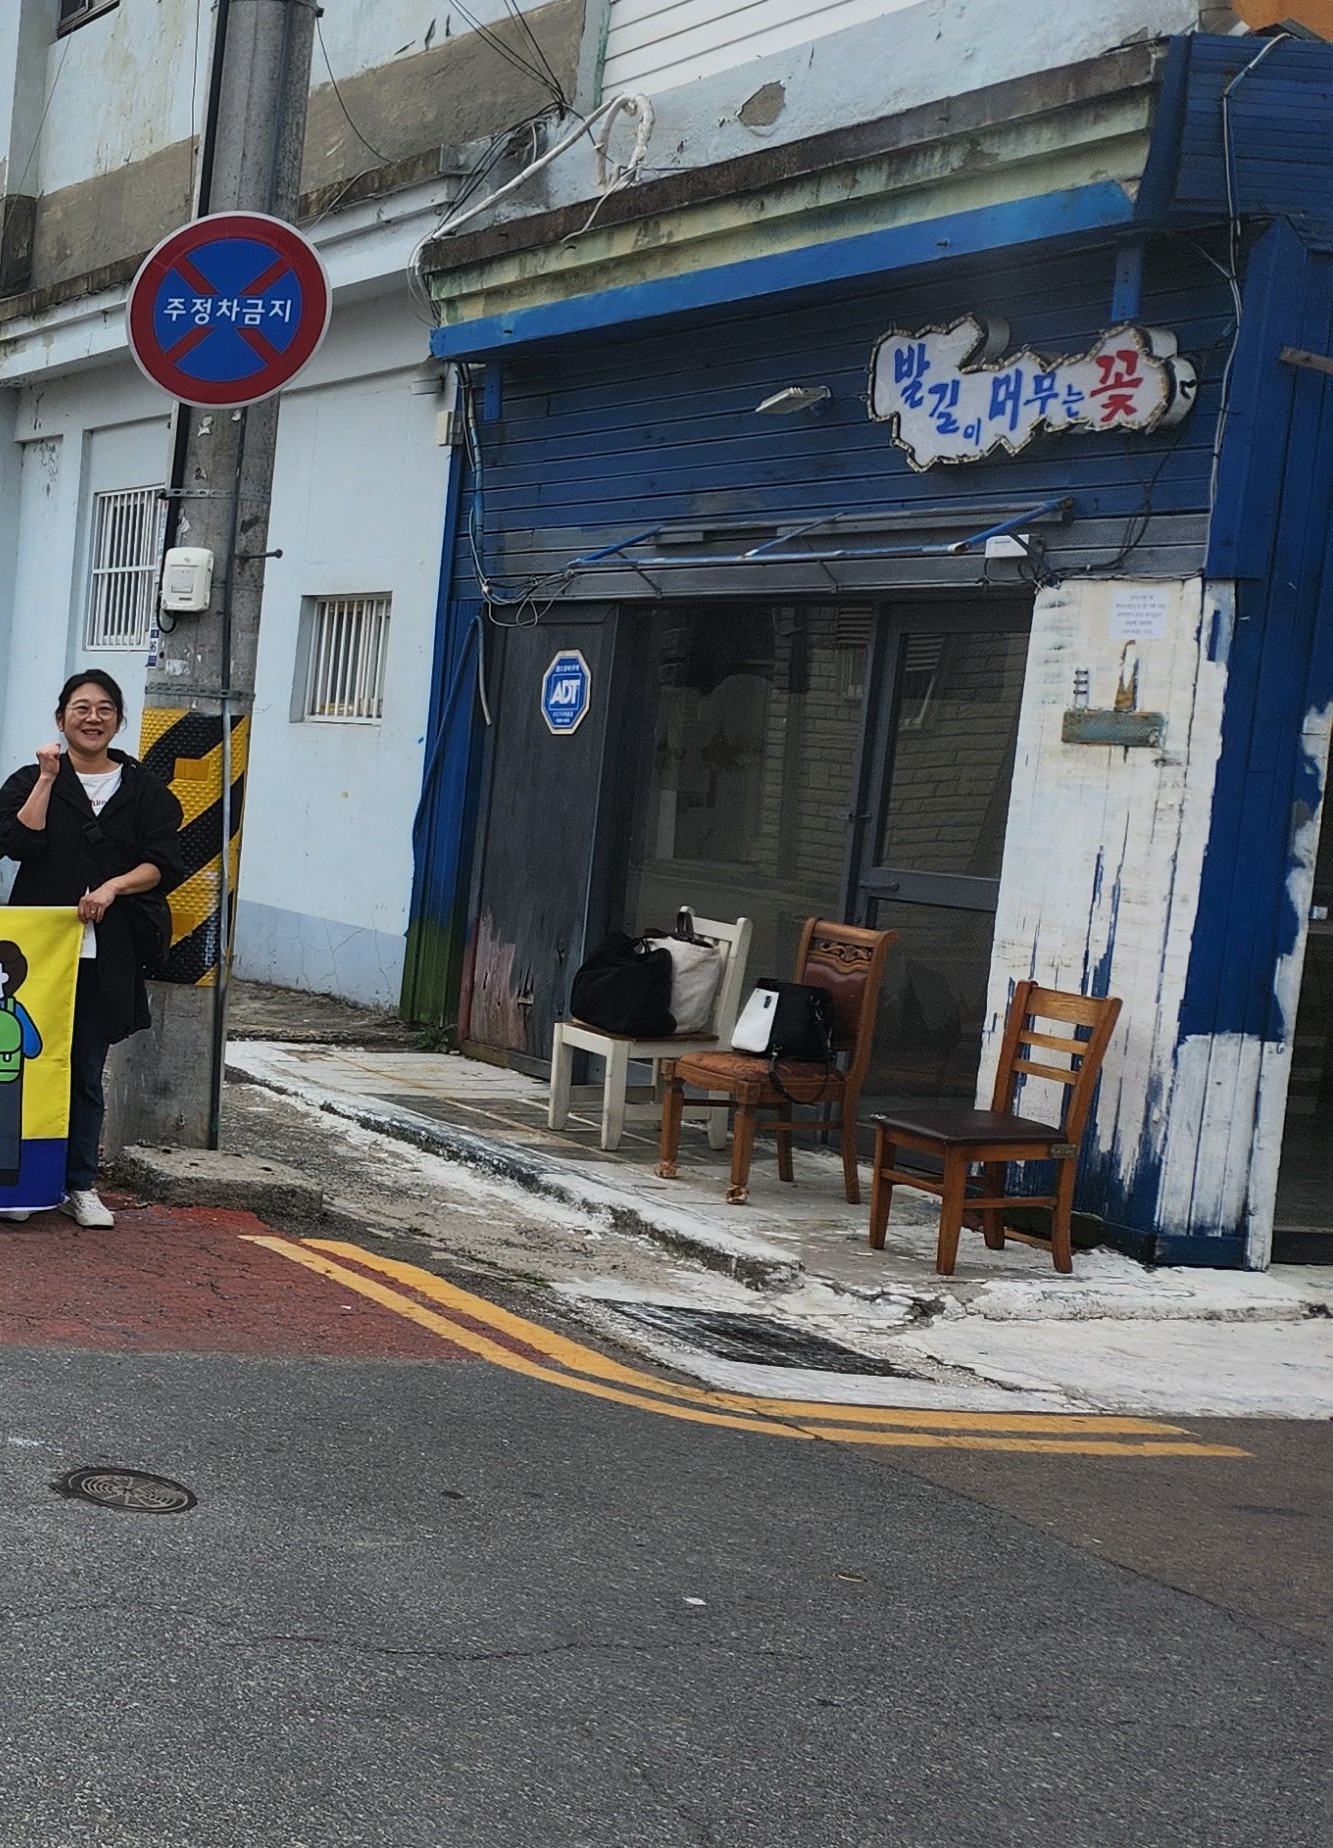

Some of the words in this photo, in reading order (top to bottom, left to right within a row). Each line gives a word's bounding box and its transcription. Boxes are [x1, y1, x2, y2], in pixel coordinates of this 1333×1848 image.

[163, 297, 293, 325] 주정차금지
[894, 342, 982, 446] 발길이
[988, 368, 1085, 431] 머무는
[1090, 349, 1143, 422] 꽃
[550, 679, 581, 704] ADT
